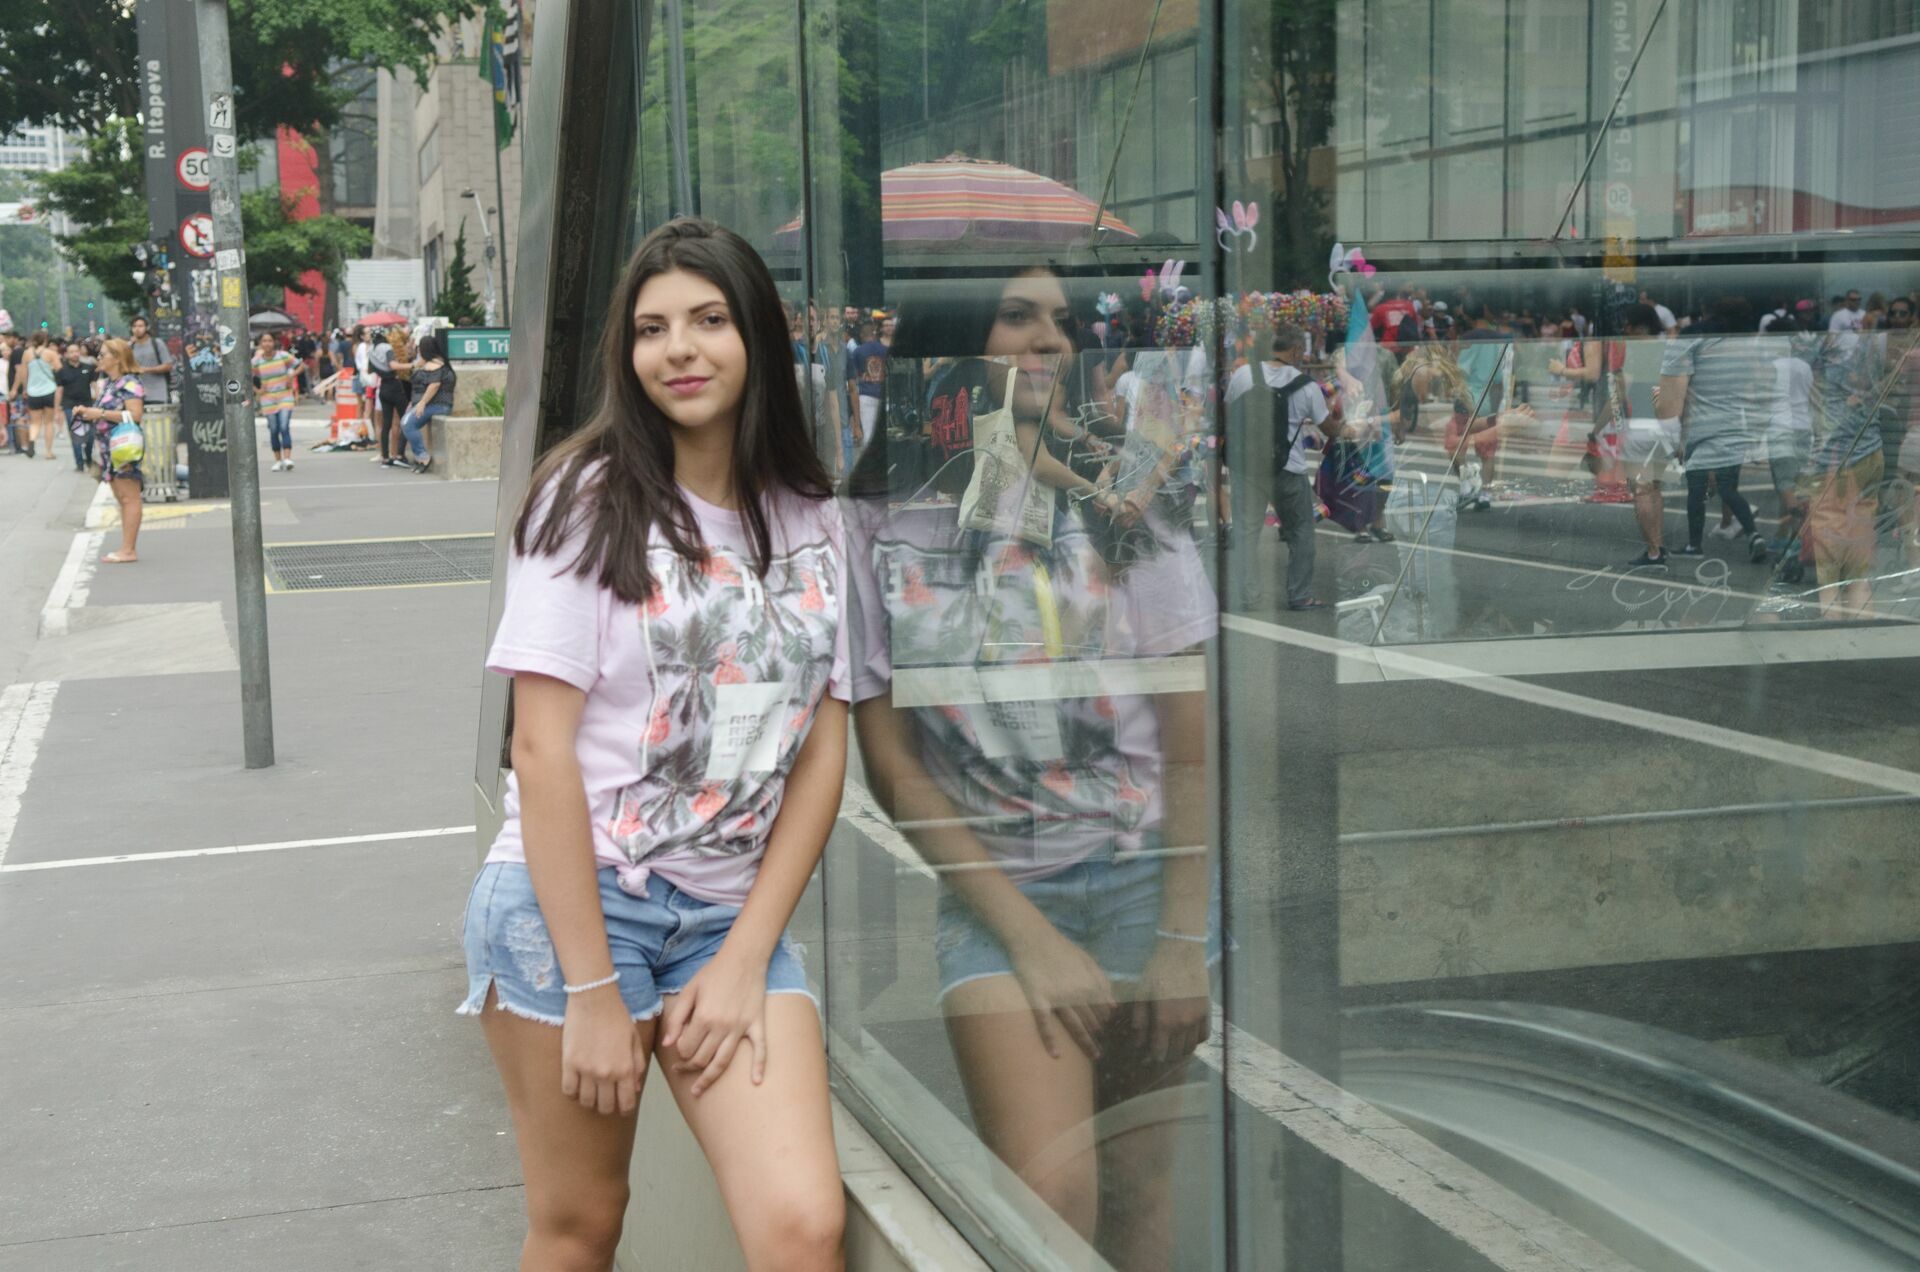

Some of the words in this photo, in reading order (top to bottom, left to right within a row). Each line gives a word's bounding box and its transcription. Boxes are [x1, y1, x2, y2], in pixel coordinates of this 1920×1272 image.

[147, 60, 166, 134] Itapeva
[148, 140, 167, 159] R.
[185, 158, 209, 176] 50
[488, 339, 509, 354] Tri
